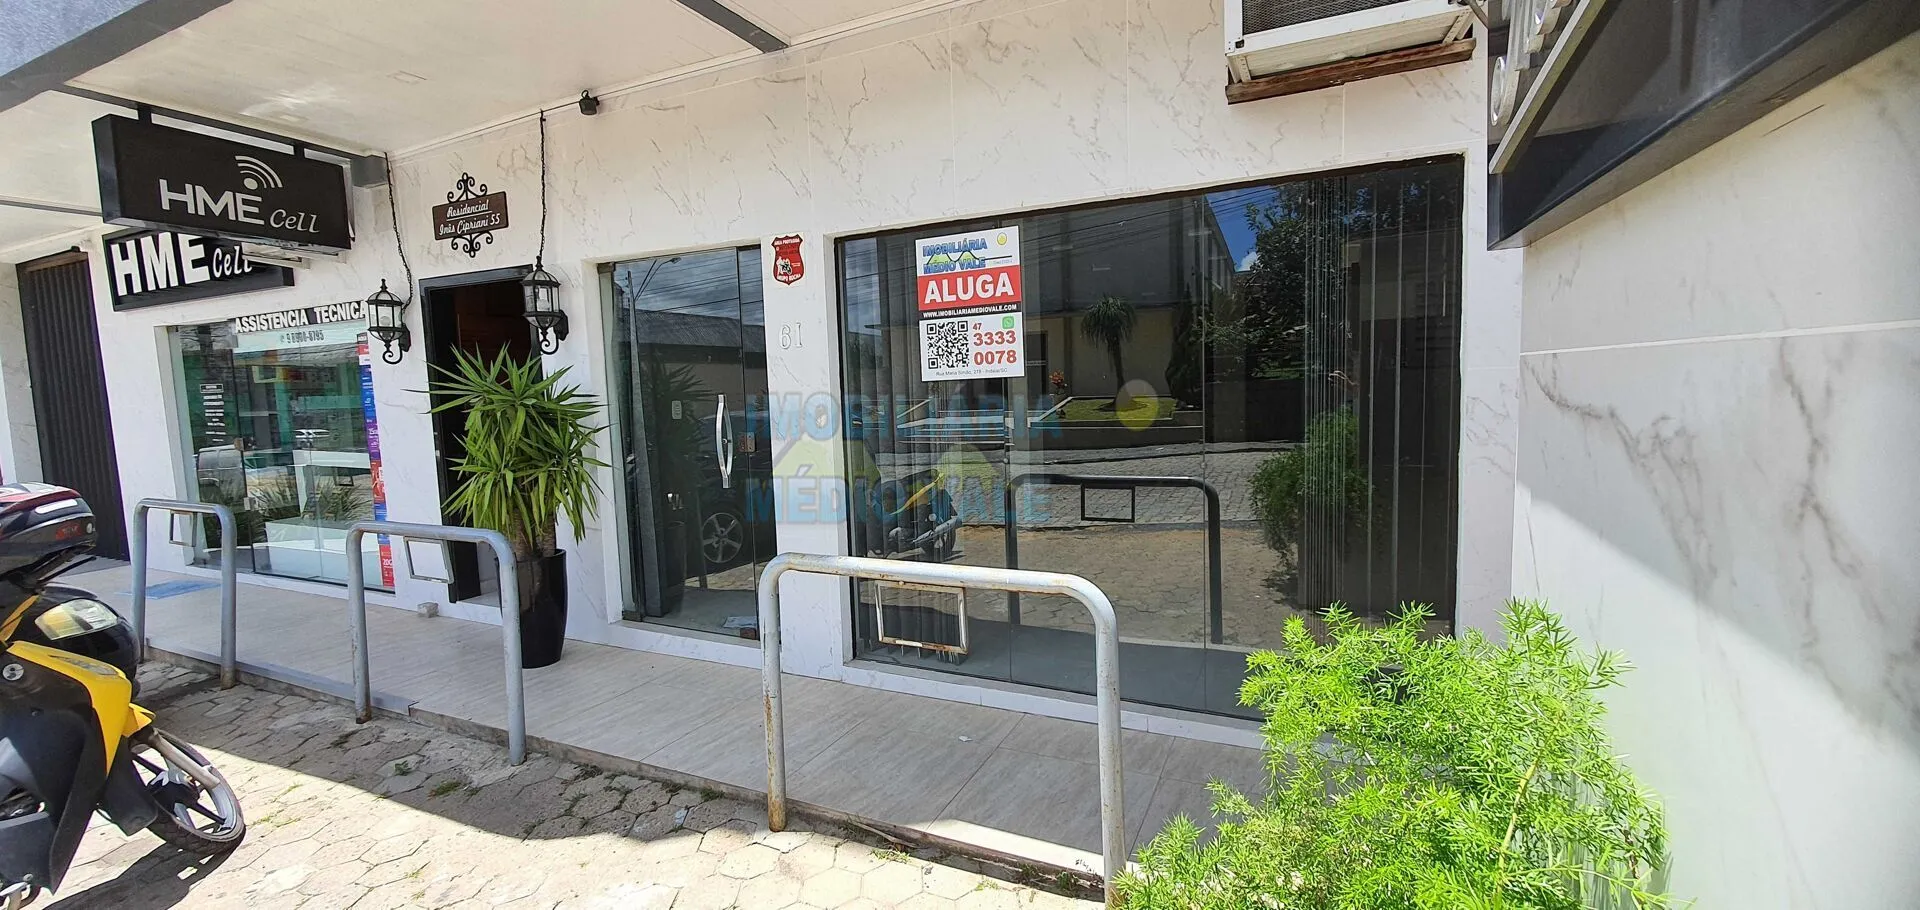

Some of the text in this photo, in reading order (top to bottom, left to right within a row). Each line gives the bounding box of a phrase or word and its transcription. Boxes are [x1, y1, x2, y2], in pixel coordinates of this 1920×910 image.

[159, 179, 320, 233] HME Cell
[446, 199, 489, 218] Residencial
[457, 214, 489, 234] Cipriani
[490, 213, 500, 225] 55
[922, 238, 987, 257] IMOBILIÁRIA
[110, 231, 252, 297] HME Cell
[958, 257, 987, 271] VALE
[924, 272, 1015, 304] ALUGA
[235, 301, 368, 334] ASSISTENCIA TECNICA
[923, 304, 1017, 318] WWW.IMOBILIARIAMEDIOVALE.COM
[780, 321, 803, 350] 61
[972, 322, 982, 331] 47
[973, 330, 1017, 346] 3333
[973, 349, 1017, 365] 0078
